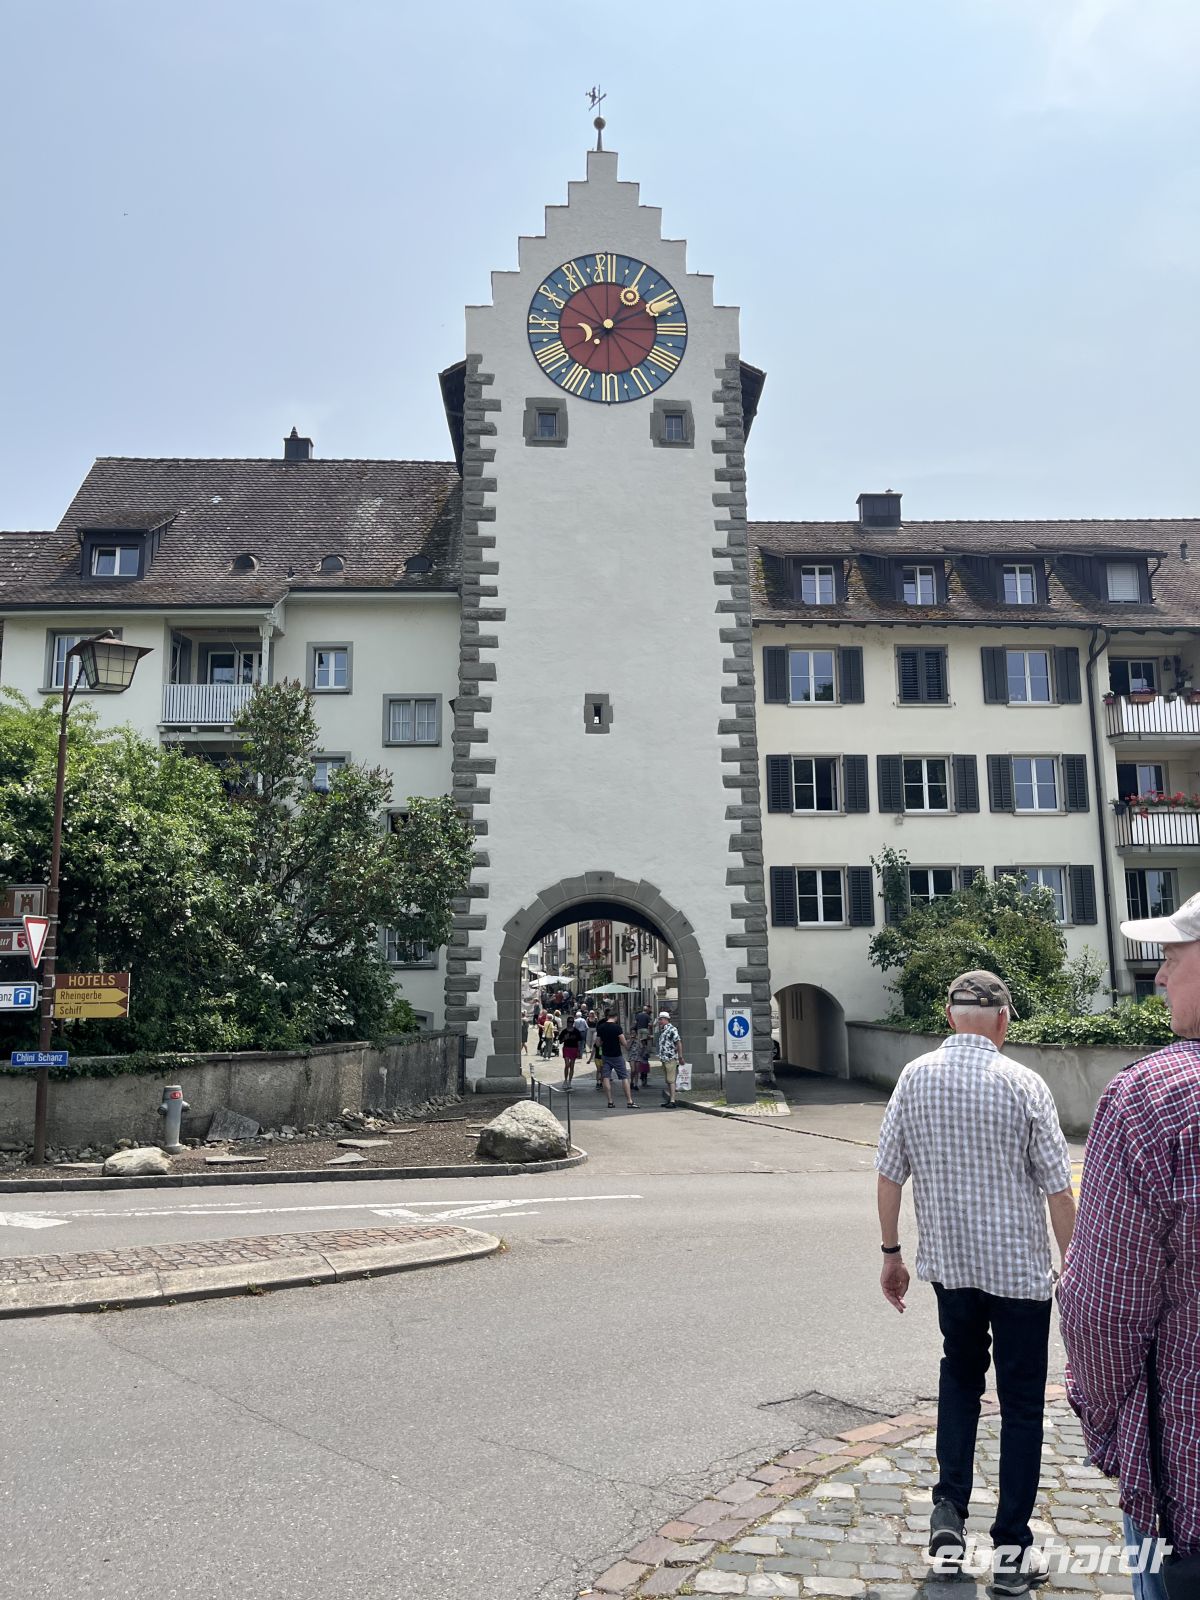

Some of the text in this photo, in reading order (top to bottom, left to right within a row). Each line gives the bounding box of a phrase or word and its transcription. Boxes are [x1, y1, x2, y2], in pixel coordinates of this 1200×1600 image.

[68, 975, 116, 987] HOTELS
[60, 991, 102, 1002] Rheingerbe
[59, 1006, 82, 1015] Schiff
[16, 1053, 63, 1063] Chlini Schanz
